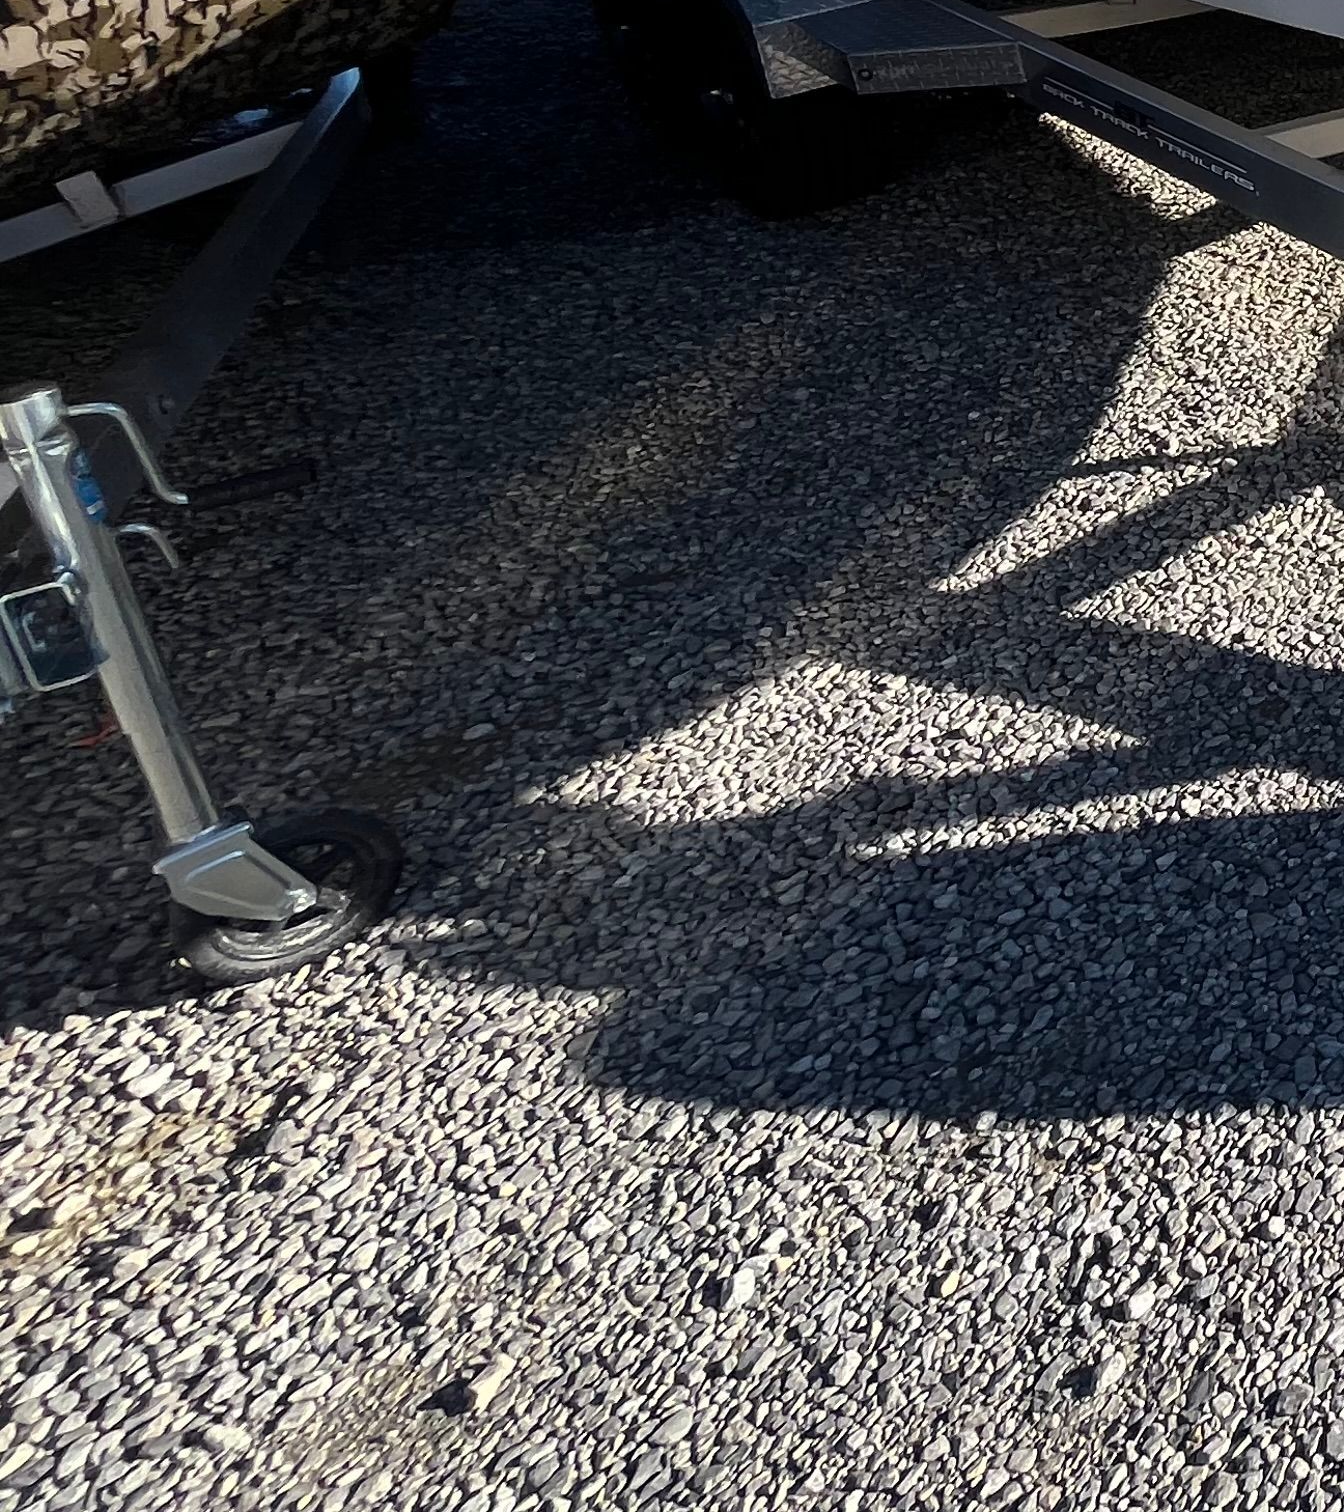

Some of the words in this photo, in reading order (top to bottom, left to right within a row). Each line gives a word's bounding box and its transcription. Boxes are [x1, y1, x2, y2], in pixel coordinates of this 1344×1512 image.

[1043, 83, 1085, 109] BACK
[1090, 106, 1149, 140] TRACK
[1156, 136, 1255, 192] TRAILERS
